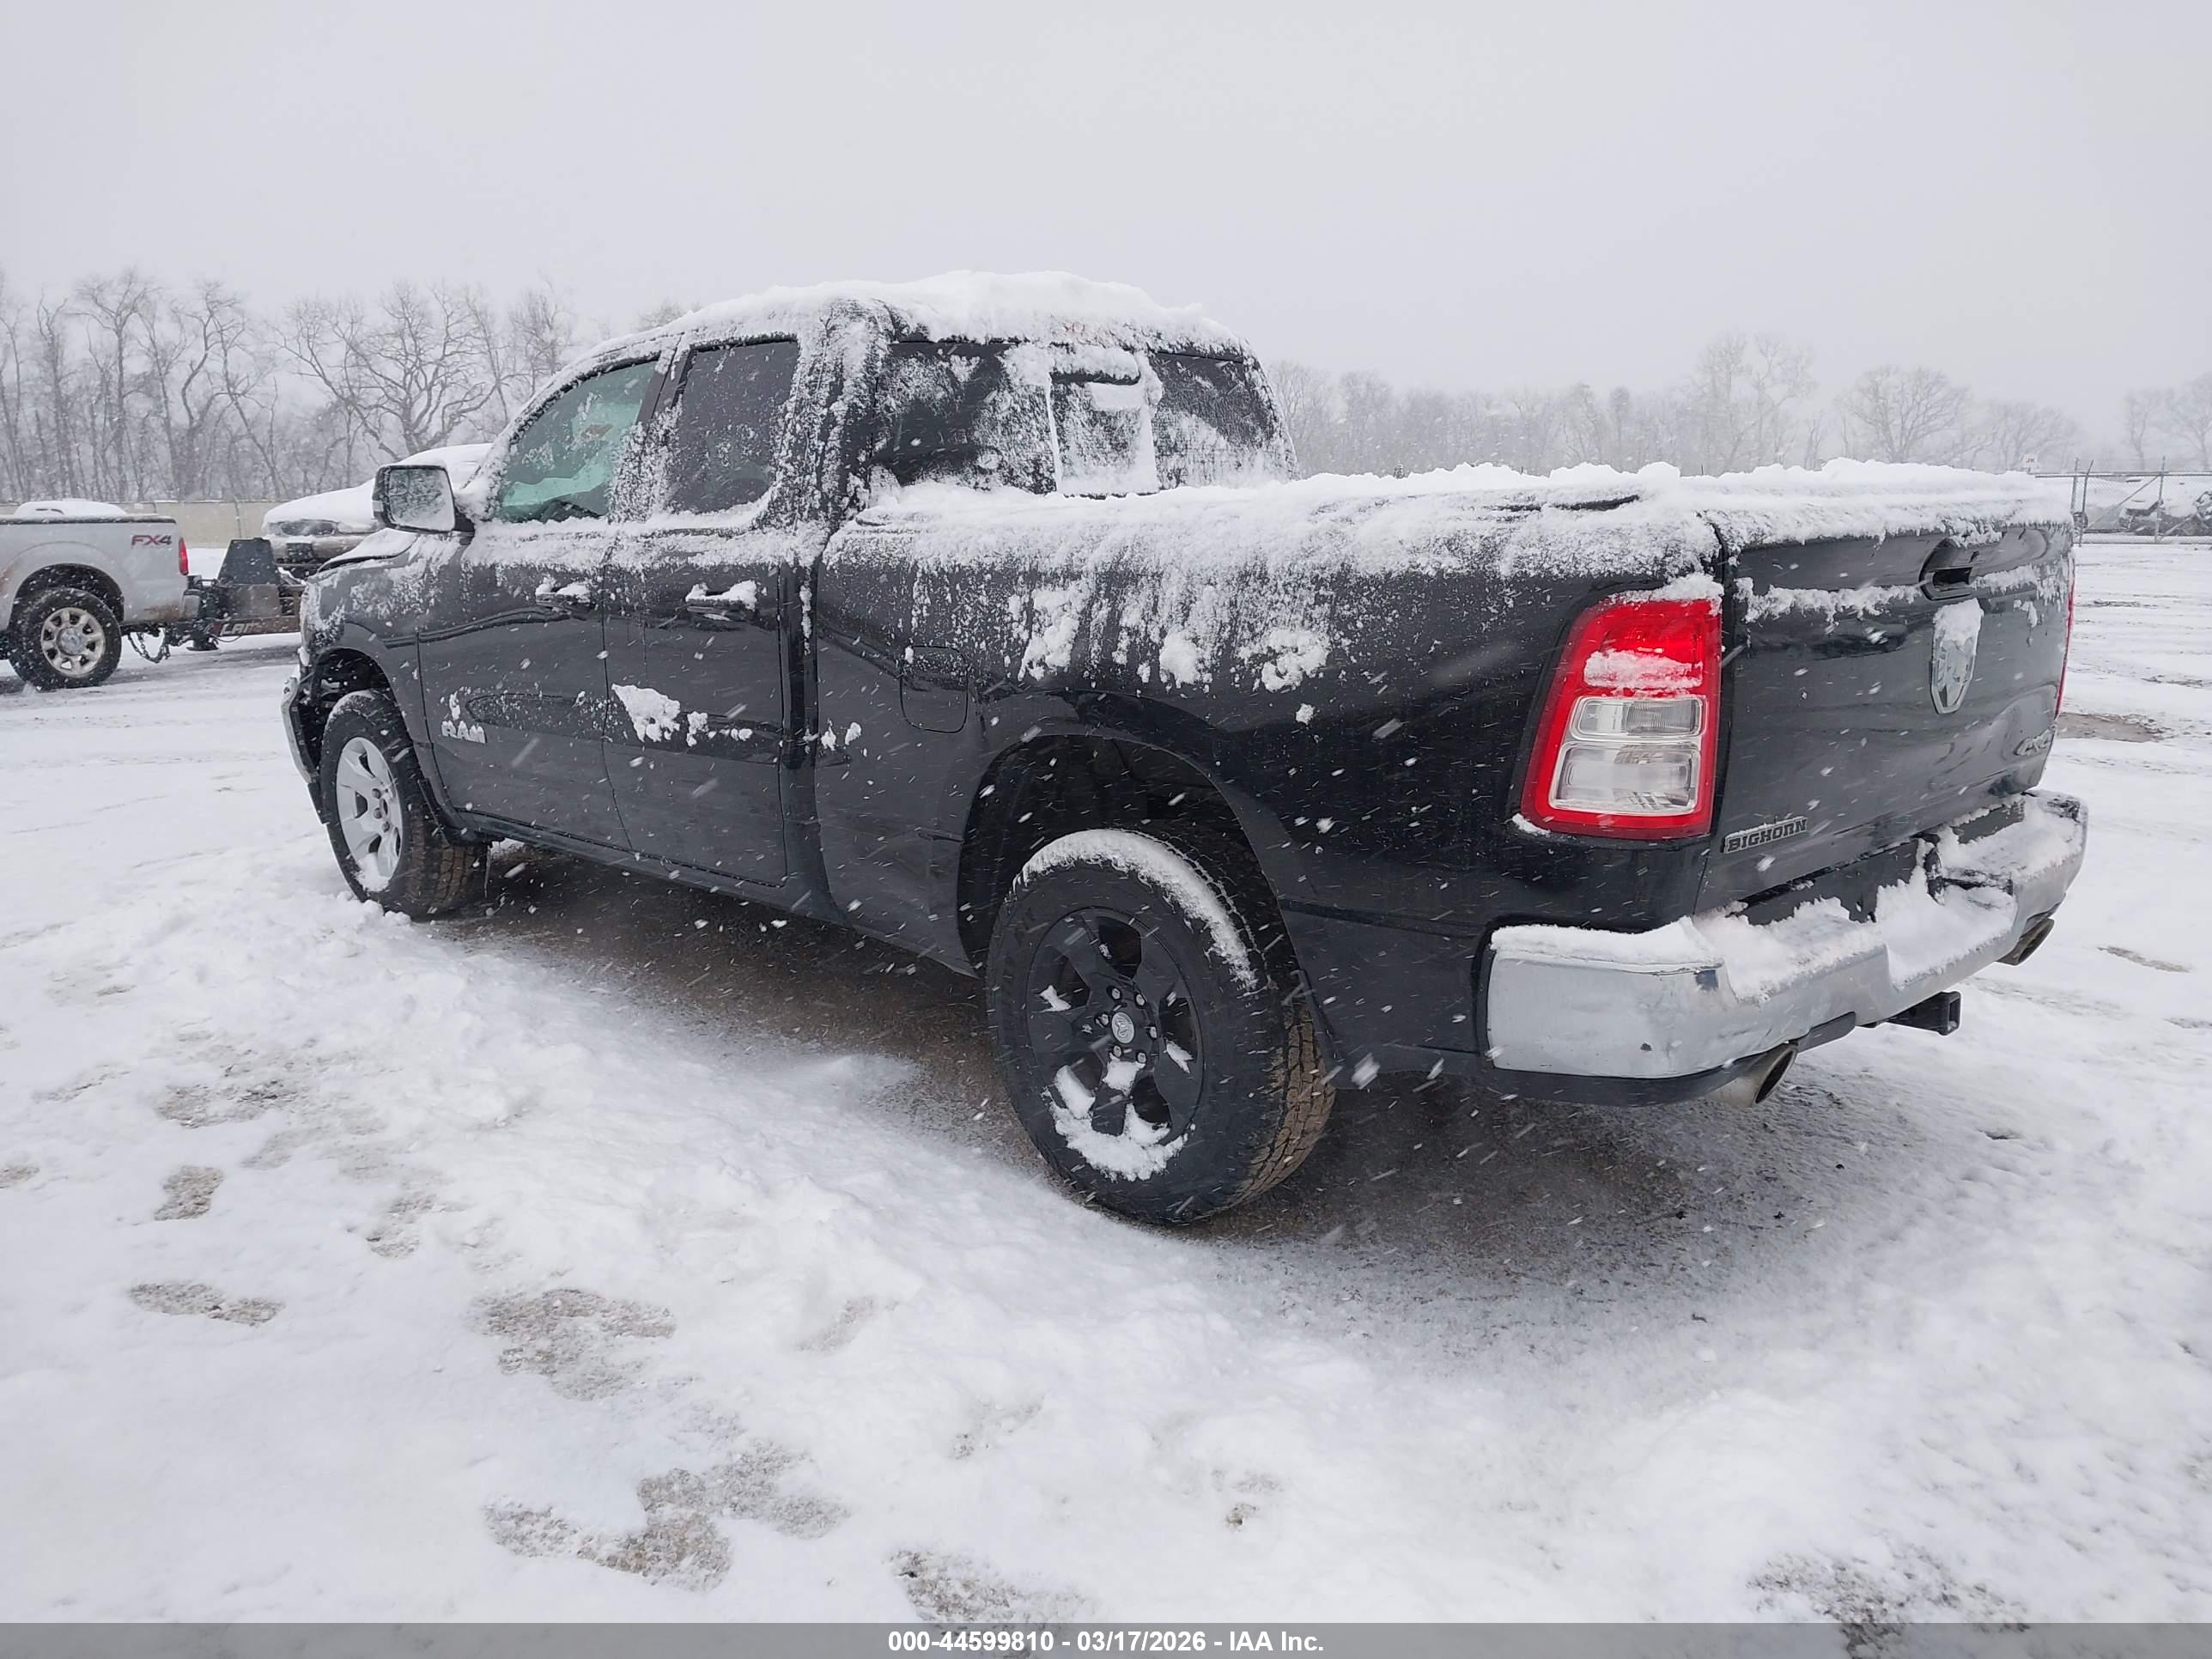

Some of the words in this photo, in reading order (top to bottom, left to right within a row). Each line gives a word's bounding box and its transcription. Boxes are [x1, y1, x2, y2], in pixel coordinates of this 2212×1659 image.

[131, 534, 172, 546] FX4
[441, 720, 487, 744] RAM
[1723, 817, 1808, 854] BIGHORN
